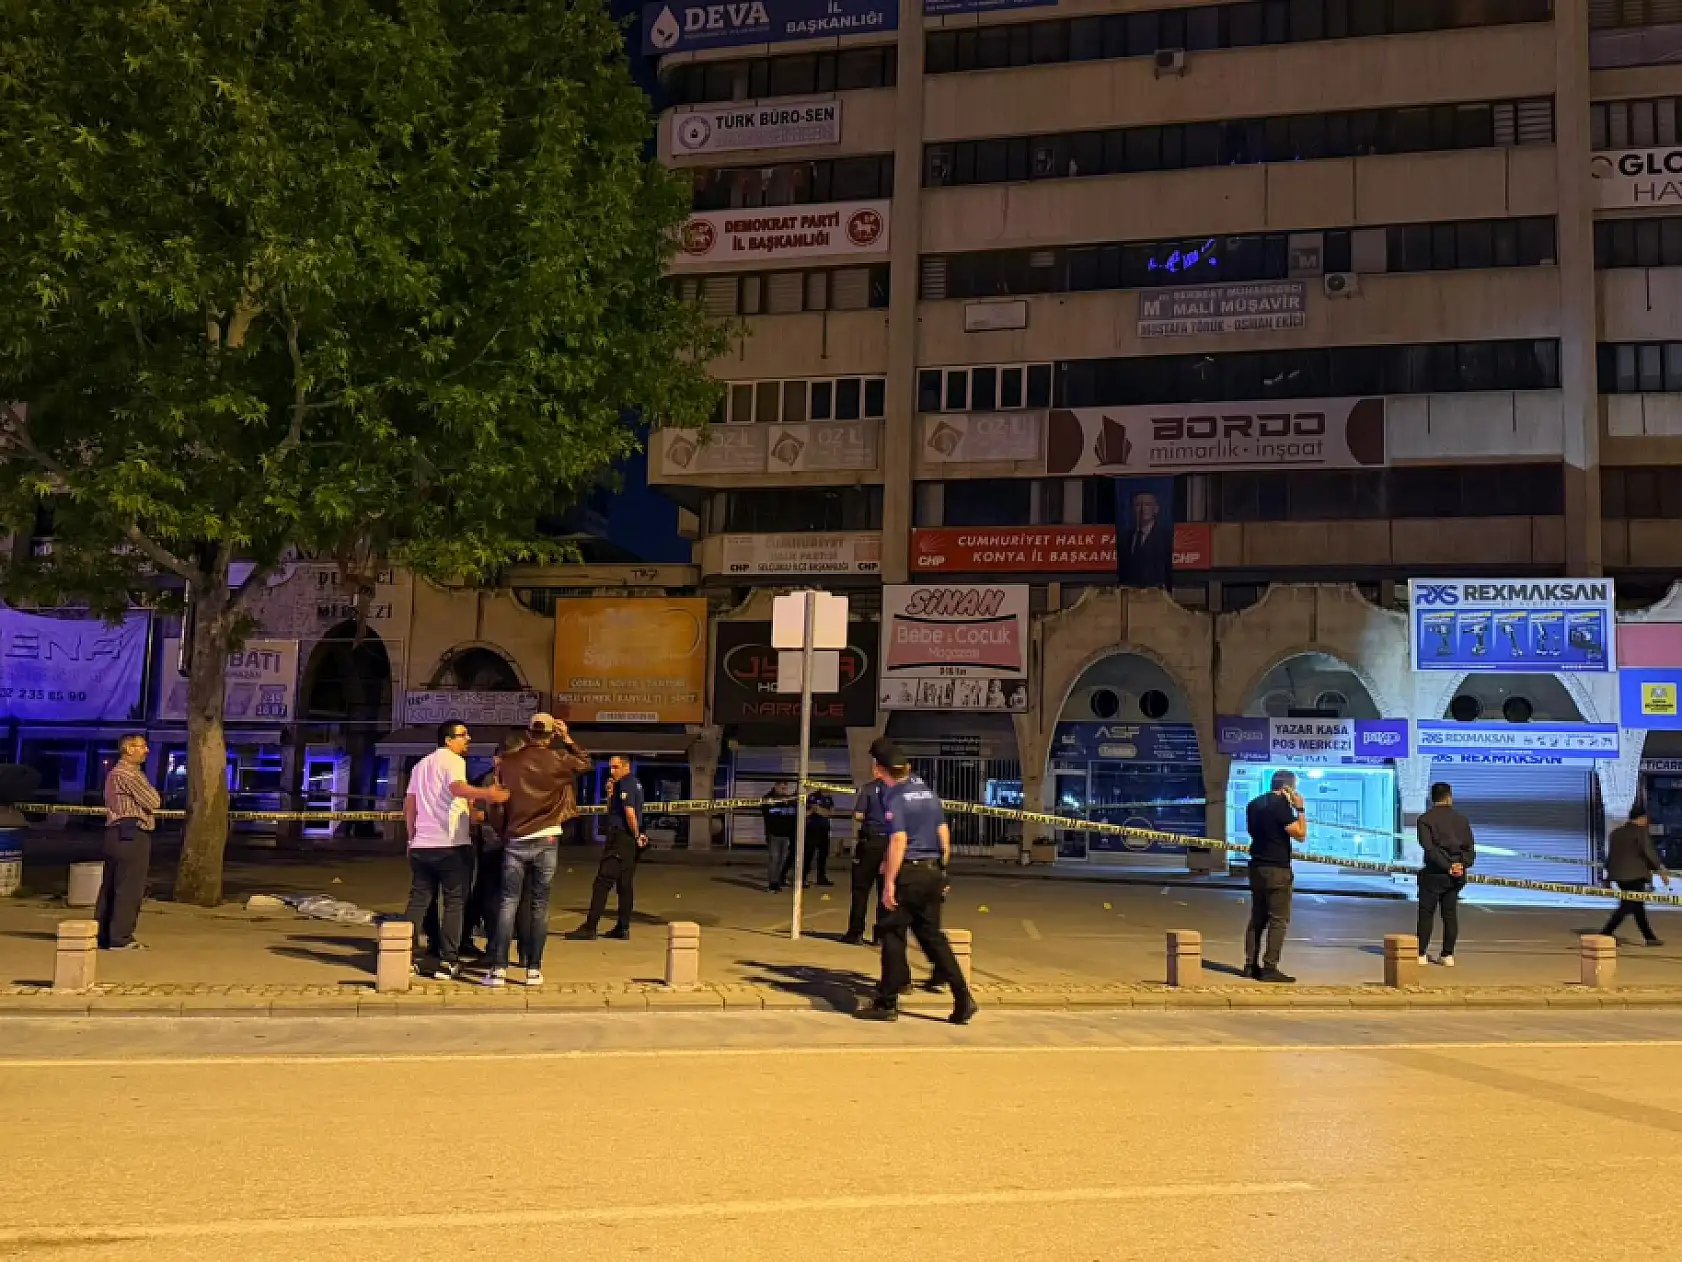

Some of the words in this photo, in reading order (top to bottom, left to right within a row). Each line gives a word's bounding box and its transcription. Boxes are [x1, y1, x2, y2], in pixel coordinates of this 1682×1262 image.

[684, 2, 770, 31] DEVA
[786, 11, 884, 34] BAŞKANLIĞI
[715, 112, 756, 130] TÜRK
[759, 106, 836, 126] BÜRO-SEN
[725, 216, 798, 233] DEMOKRAT
[801, 210, 840, 229] PARTİ
[732, 235, 746, 251] İL
[749, 230, 831, 252] BAŞKANLIĞI
[1173, 299, 1215, 316] MALİ
[1220, 293, 1301, 313] MÜŞAVİR
[1151, 439, 1240, 460] mimarlık
[1256, 438, 1325, 461] inşaat
[958, 533, 1051, 547] CUMHURİYET
[1055, 534, 1095, 546] HALK
[918, 555, 945, 566] CHP
[972, 551, 1026, 563] KONYA
[1031, 547, 1043, 562] İL
[1172, 552, 1200, 564] CHP
[730, 563, 750, 572] CHP
[857, 562, 879, 571] CHP
[1463, 584, 1607, 600] REXMAKSAN
[896, 625, 944, 644] Bebe
[1275, 724, 1313, 735] YAZAR
[1316, 724, 1348, 735] KASA
[1272, 739, 1295, 750] POS
[1445, 732, 1516, 745] REXMAKSAN
